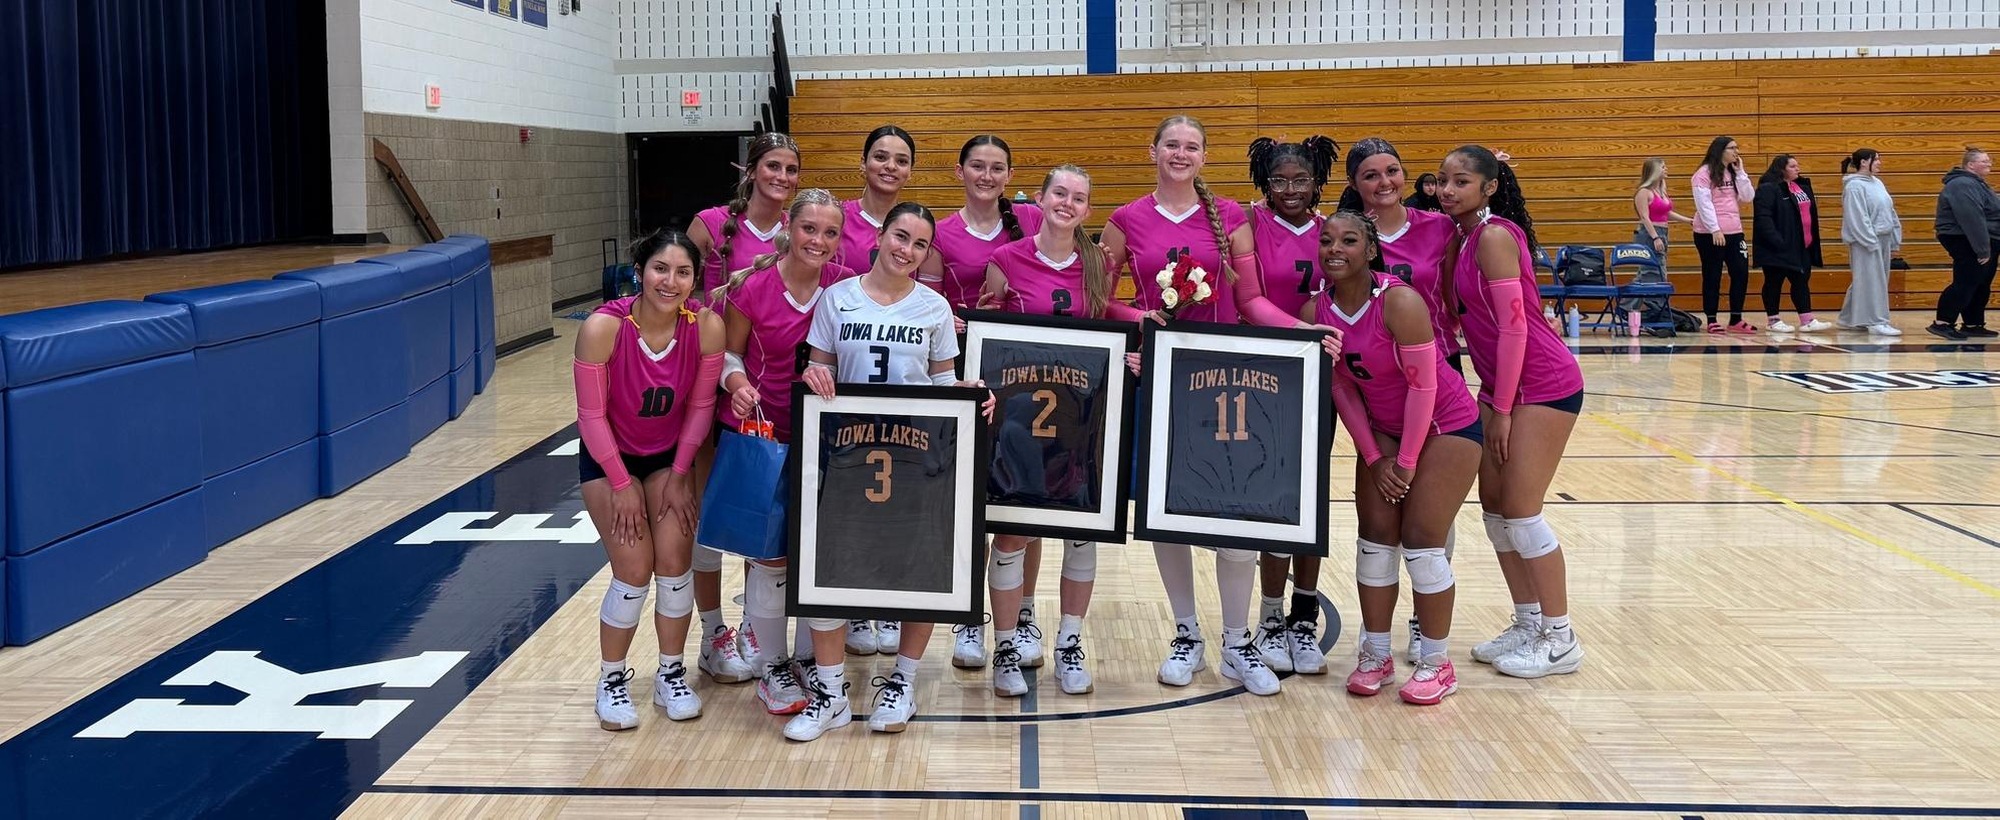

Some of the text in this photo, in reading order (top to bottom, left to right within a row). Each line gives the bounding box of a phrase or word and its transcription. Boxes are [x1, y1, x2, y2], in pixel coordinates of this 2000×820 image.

[684, 92, 700, 105] EXIT
[1295, 260, 1314, 293] 7
[1052, 288, 1072, 316] 2
[839, 323, 923, 345] IOWA LAKES
[868, 345, 890, 383] 3
[1001, 365, 1089, 389] IOWA LAKES
[1189, 368, 1279, 394] IOWA LAKES
[638, 386, 675, 418] 10
[1032, 389, 1057, 438] 2
[1215, 391, 1249, 441] 11
[835, 423, 929, 451] IOWA LAKES
[865, 450, 893, 503] 3
